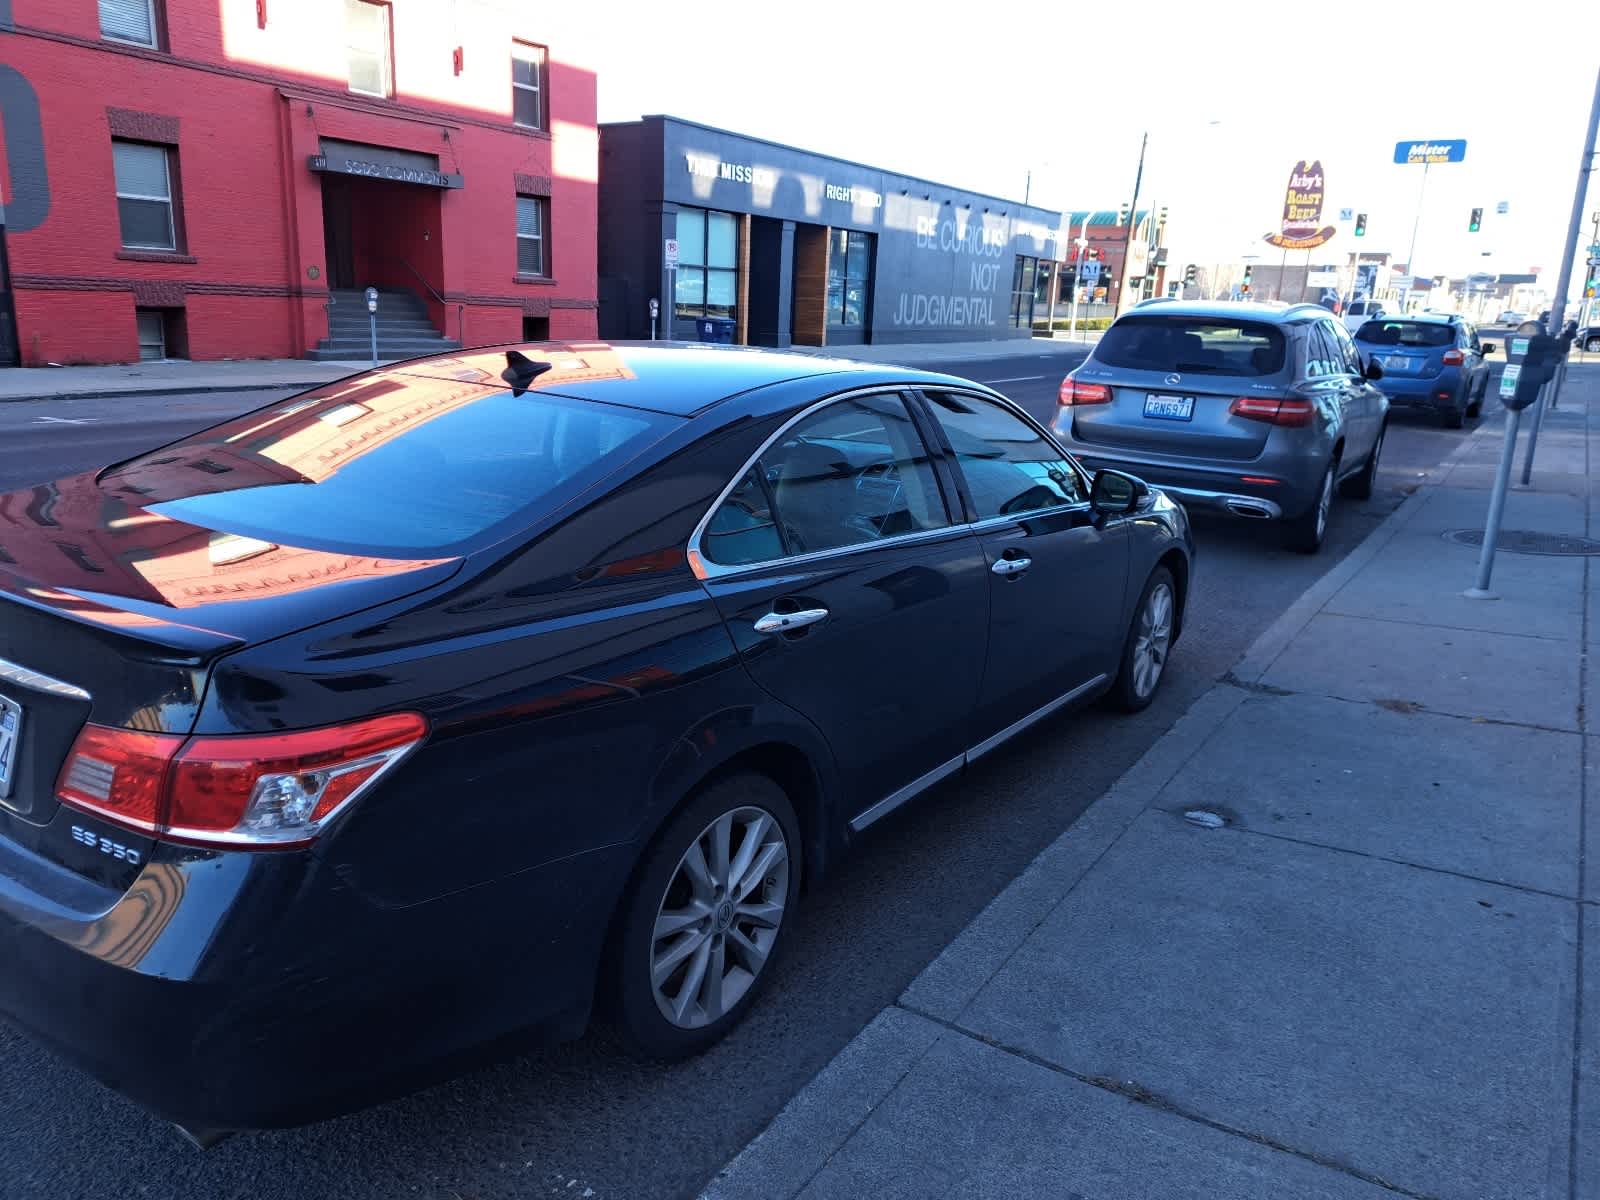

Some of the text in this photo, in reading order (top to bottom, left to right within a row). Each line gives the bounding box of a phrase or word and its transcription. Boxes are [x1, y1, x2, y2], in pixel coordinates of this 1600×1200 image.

[1408, 144, 1453, 155] Mister
[385, 165, 449, 185] COMMONS
[1290, 173, 1322, 191] Arby's
[917, 215, 938, 249] BE
[941, 220, 1002, 257] CURIOUS
[970, 262, 1001, 293] NOT
[894, 294, 996, 326] JUDGMENTAL
[71, 825, 141, 865] ES 350
